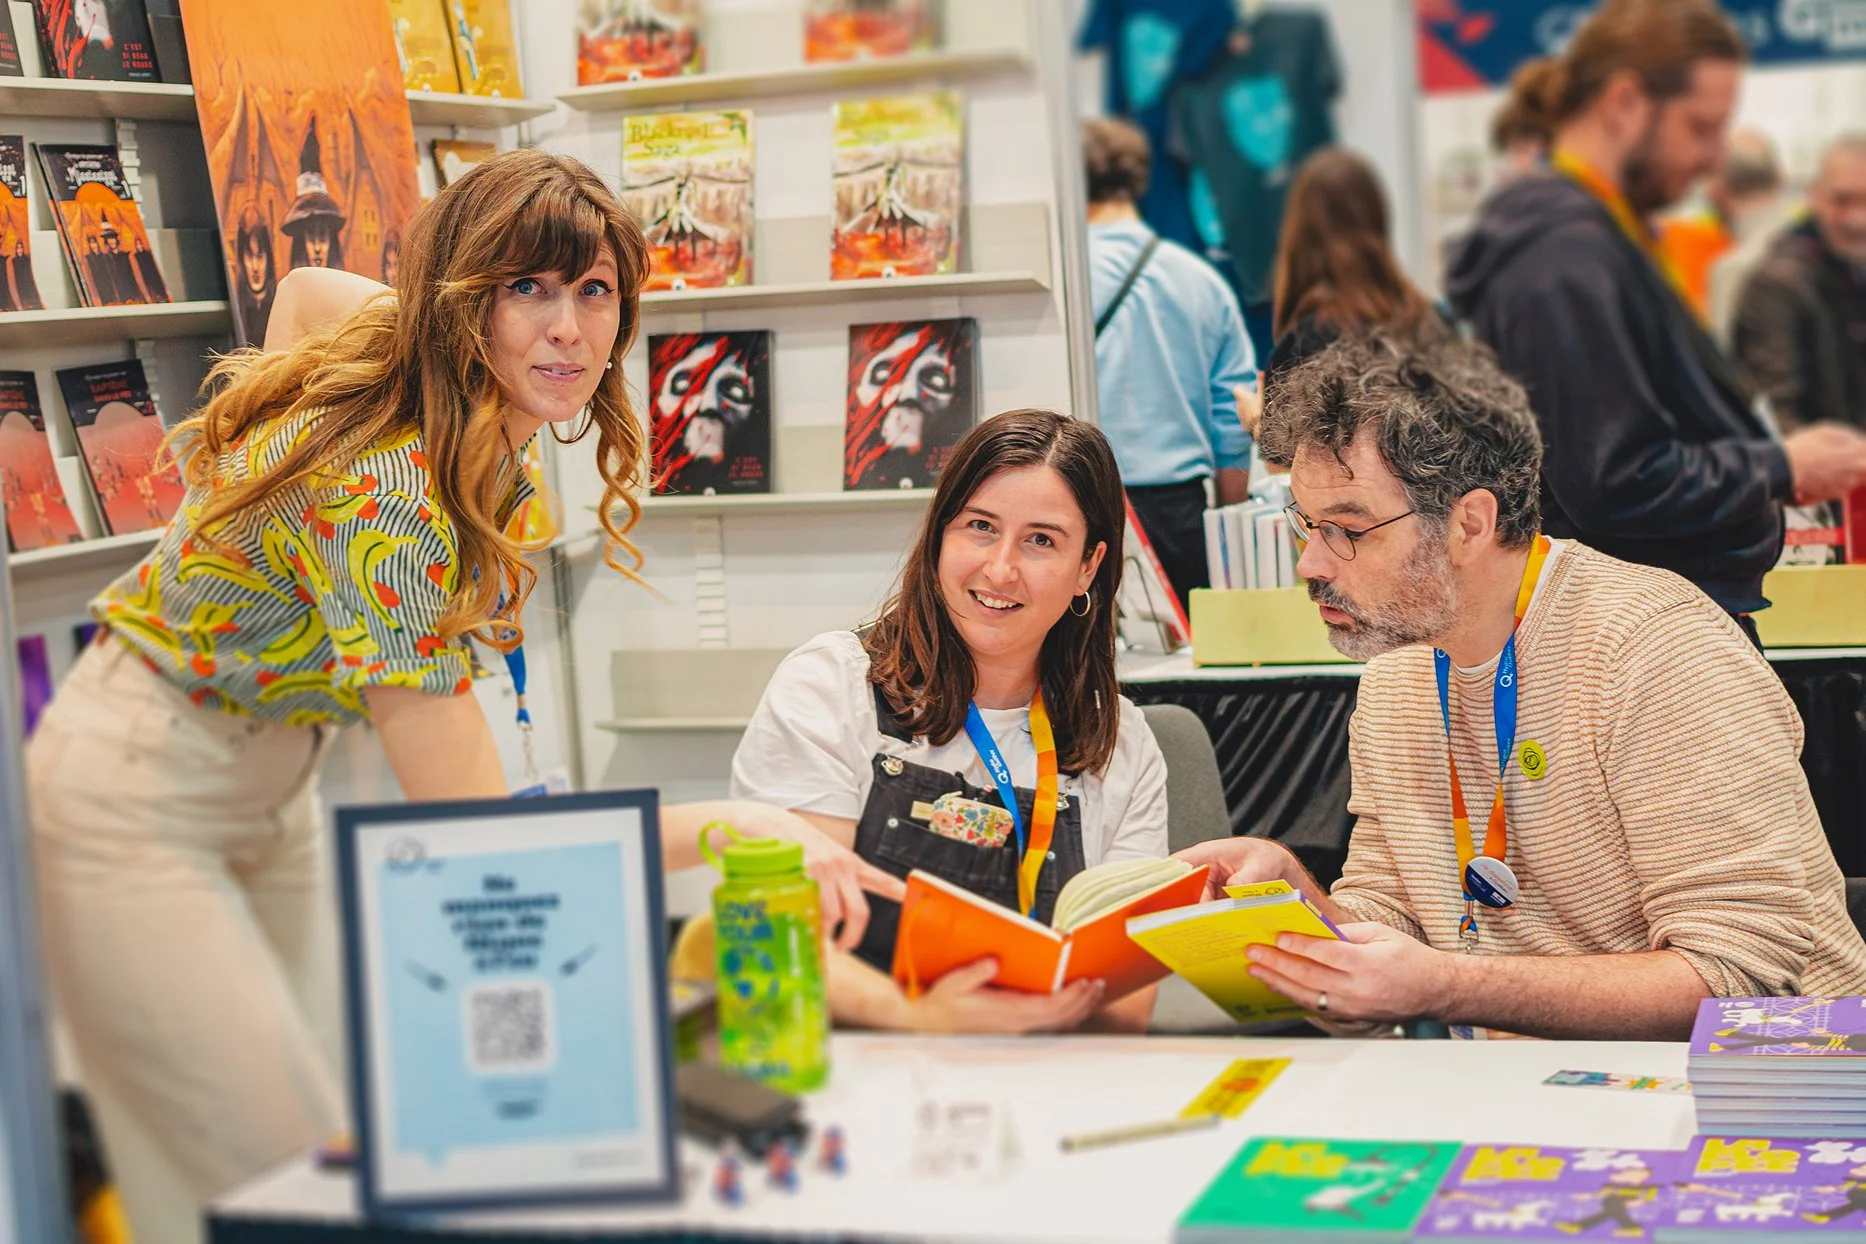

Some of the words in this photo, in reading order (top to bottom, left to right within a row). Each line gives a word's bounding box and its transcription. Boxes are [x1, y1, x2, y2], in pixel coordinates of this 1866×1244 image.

[1500, 673, 1514, 688] Q
[997, 769, 1009, 784] Q
[719, 900, 768, 921] LOVE
[719, 922, 775, 943] YOUR
